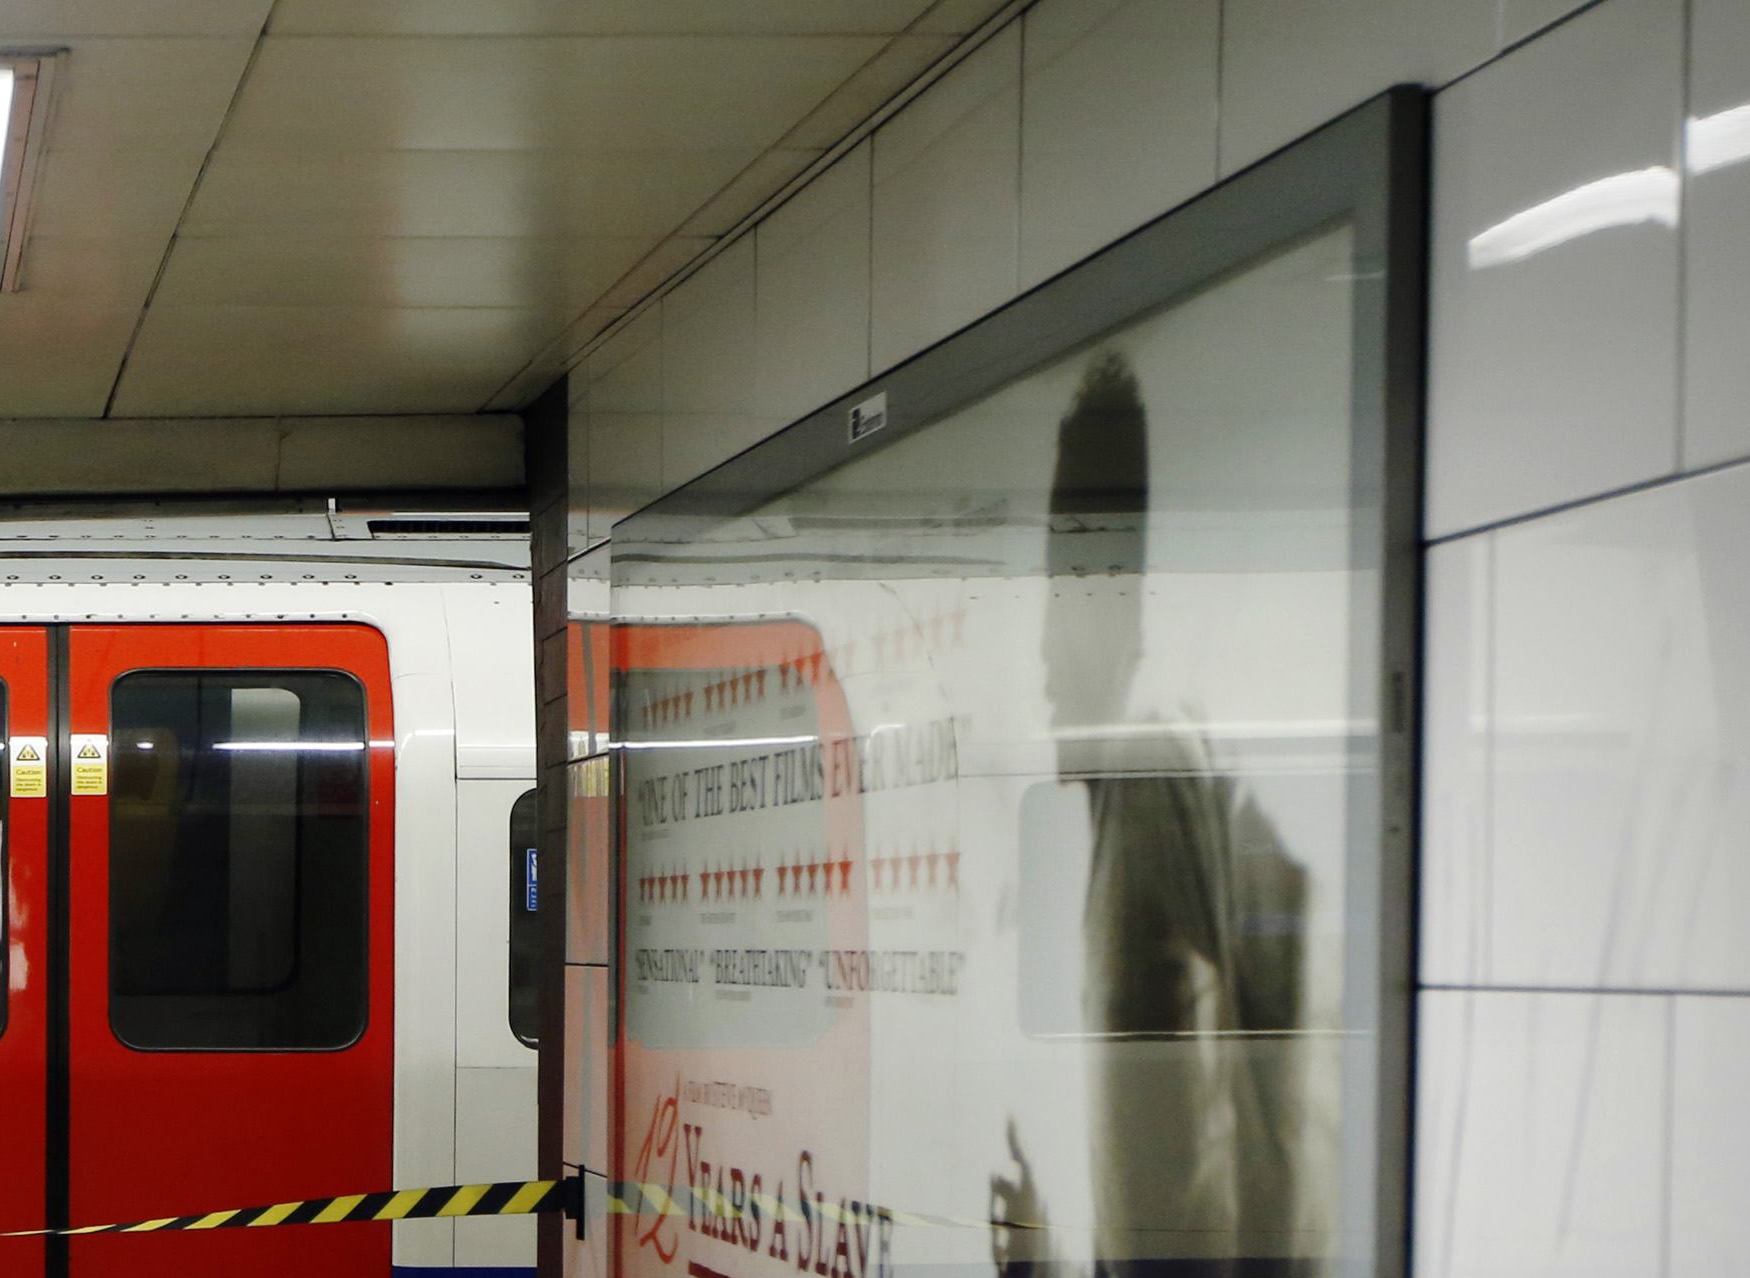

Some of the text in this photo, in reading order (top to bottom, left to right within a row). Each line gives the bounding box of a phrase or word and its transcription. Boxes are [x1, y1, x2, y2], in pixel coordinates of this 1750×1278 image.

[694, 763, 724, 820] THE
[729, 755, 769, 814] BEST
[773, 742, 825, 807] FILMS
[683, 1122, 762, 1253] YEARS
[768, 1179, 789, 1263] A
